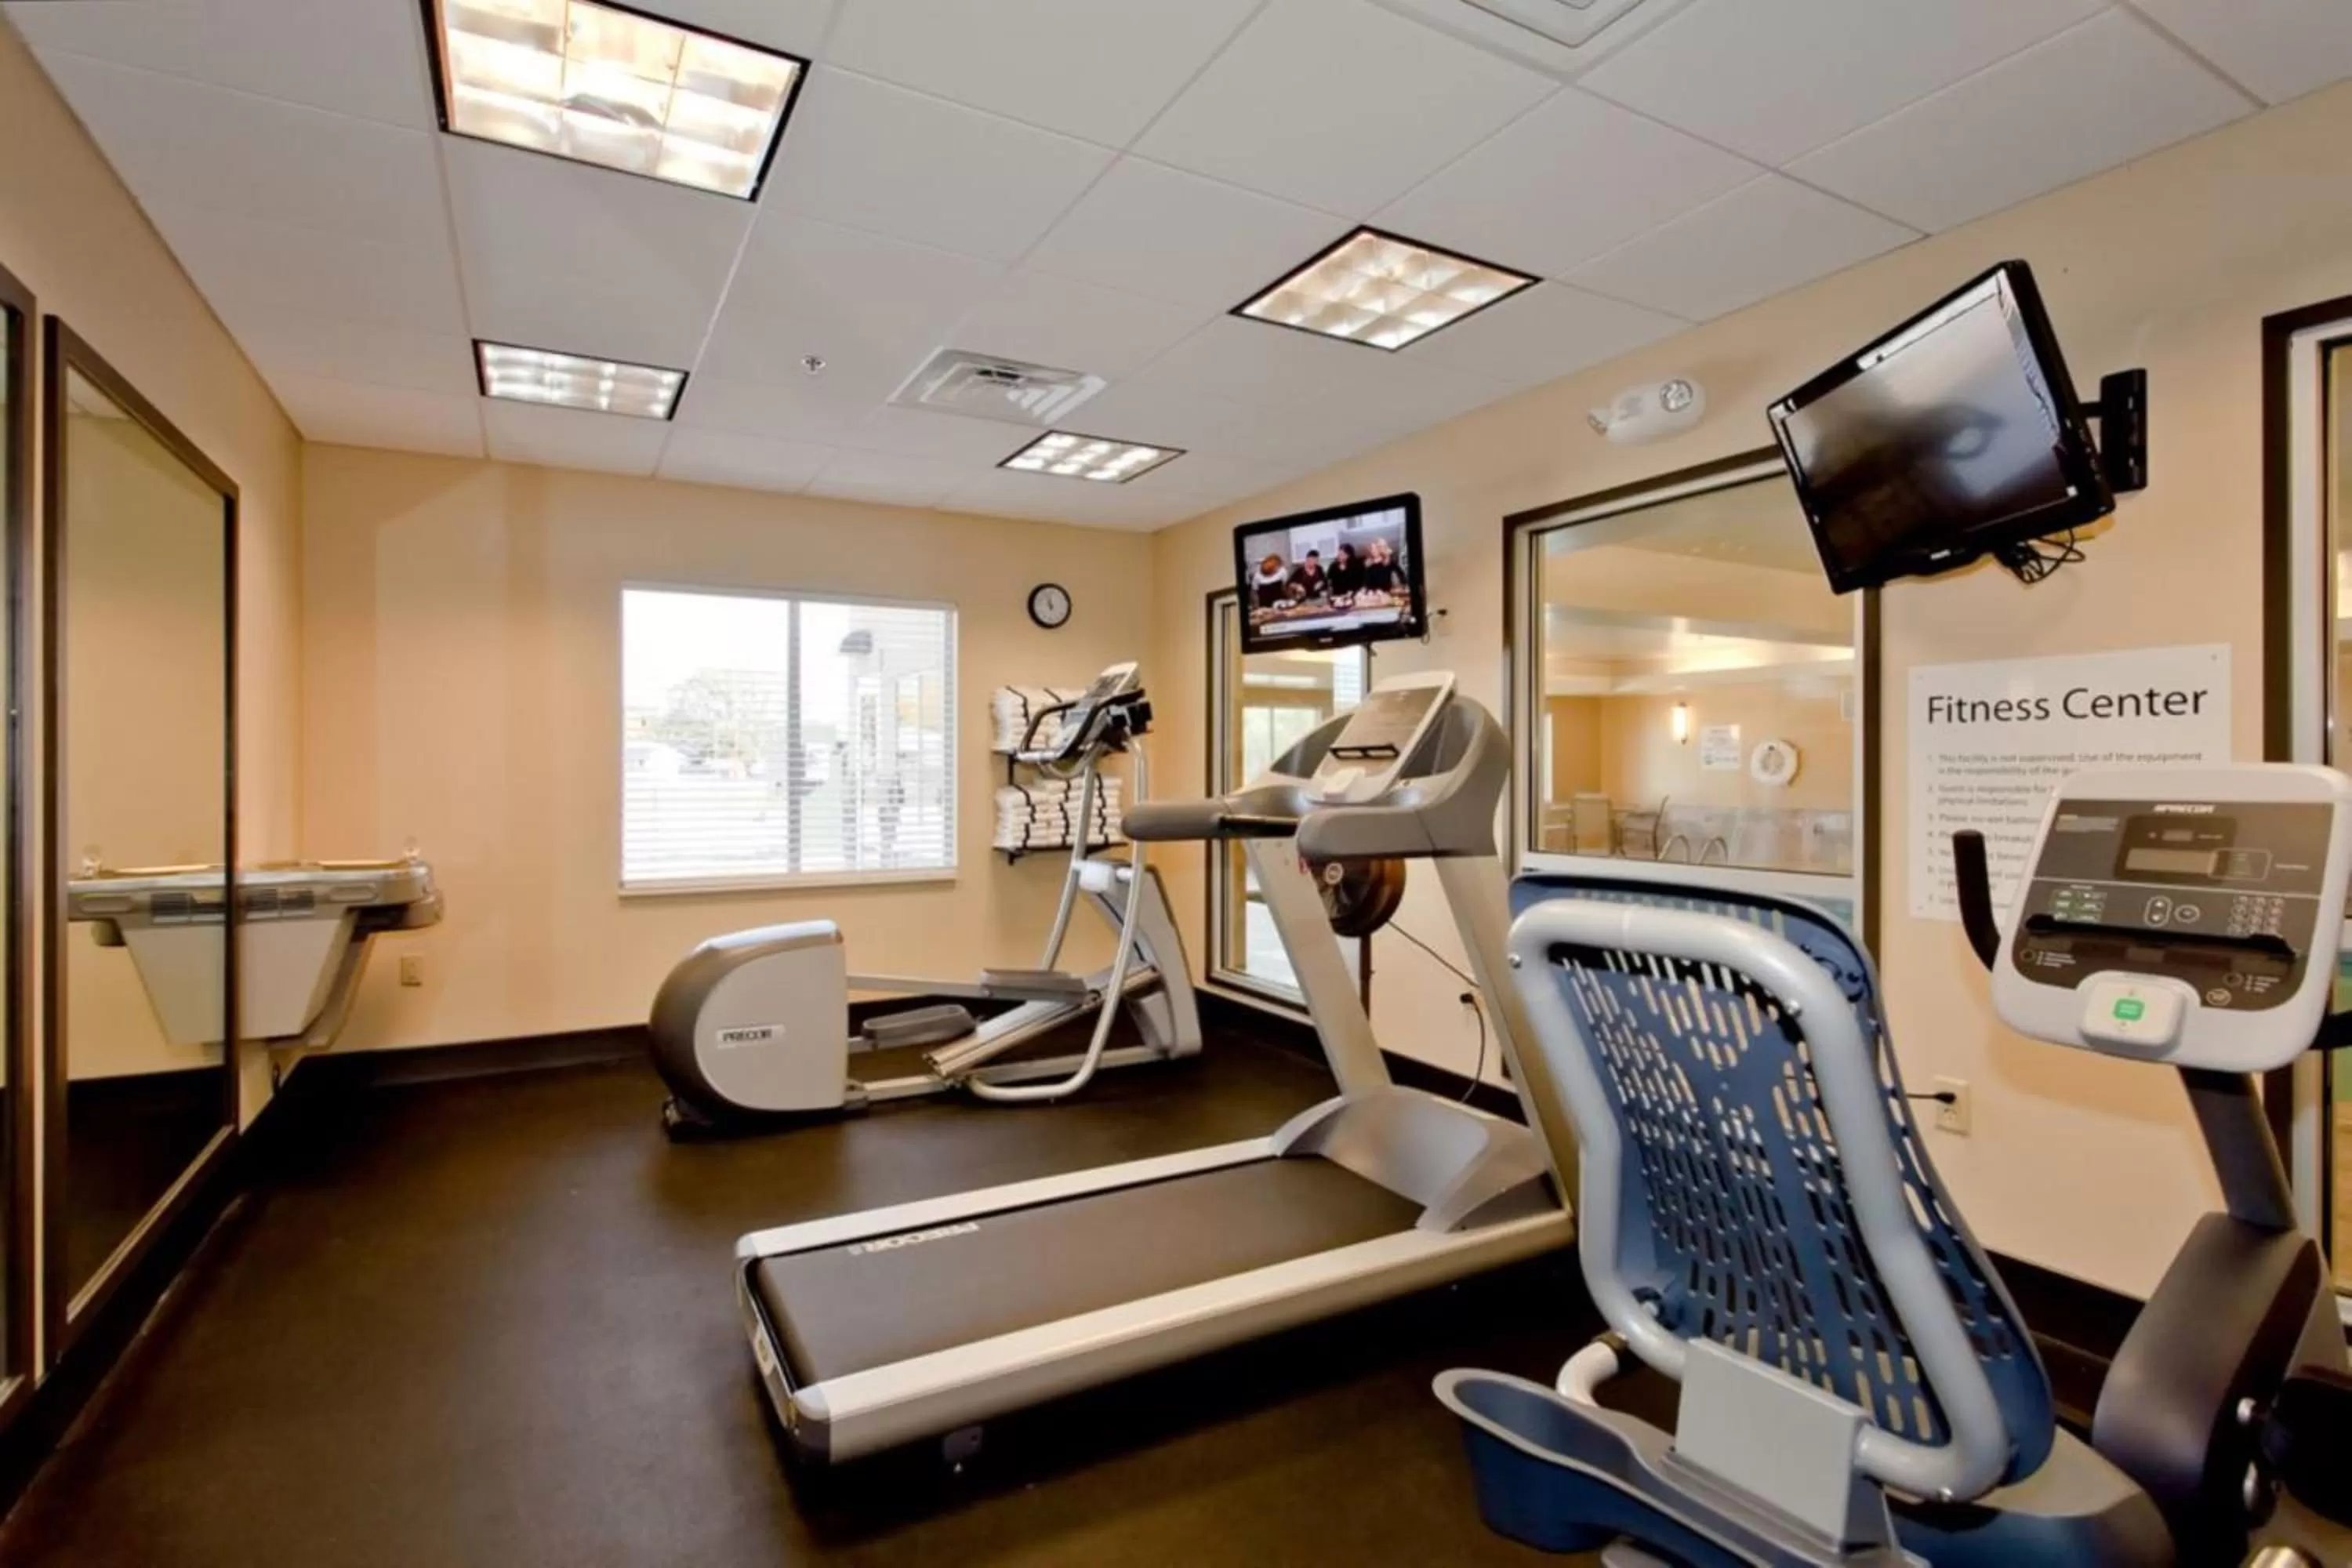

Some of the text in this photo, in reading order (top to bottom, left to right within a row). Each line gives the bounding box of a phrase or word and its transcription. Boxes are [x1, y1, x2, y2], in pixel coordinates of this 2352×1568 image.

[1927, 687, 2209, 724] Fitness Center
[722, 1029, 772, 1042] PRECOR
